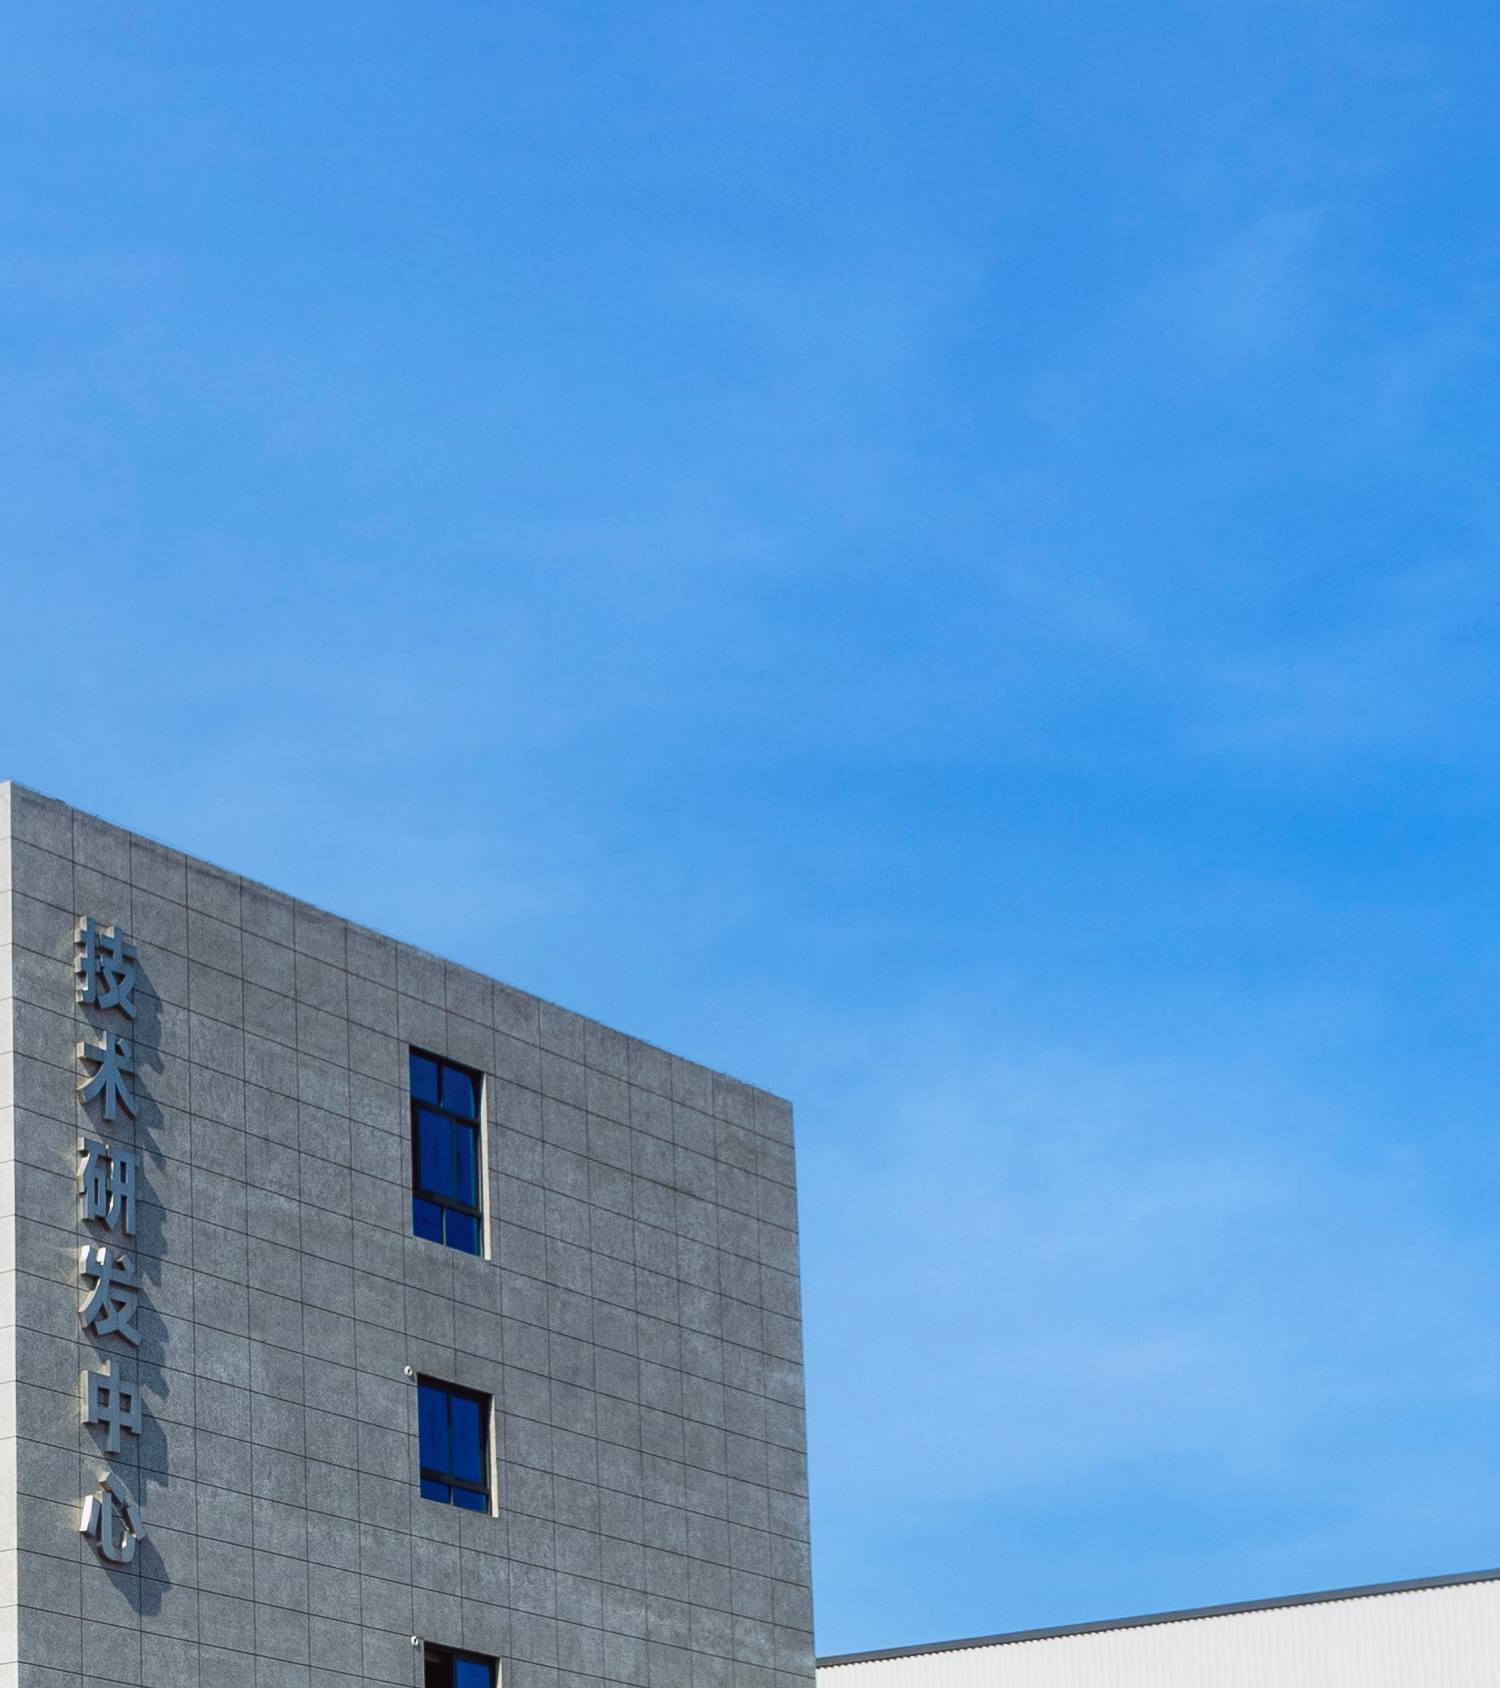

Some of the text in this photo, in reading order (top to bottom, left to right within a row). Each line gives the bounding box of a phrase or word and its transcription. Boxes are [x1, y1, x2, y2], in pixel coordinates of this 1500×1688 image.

[75, 915, 146, 1565] 技术研发中心
